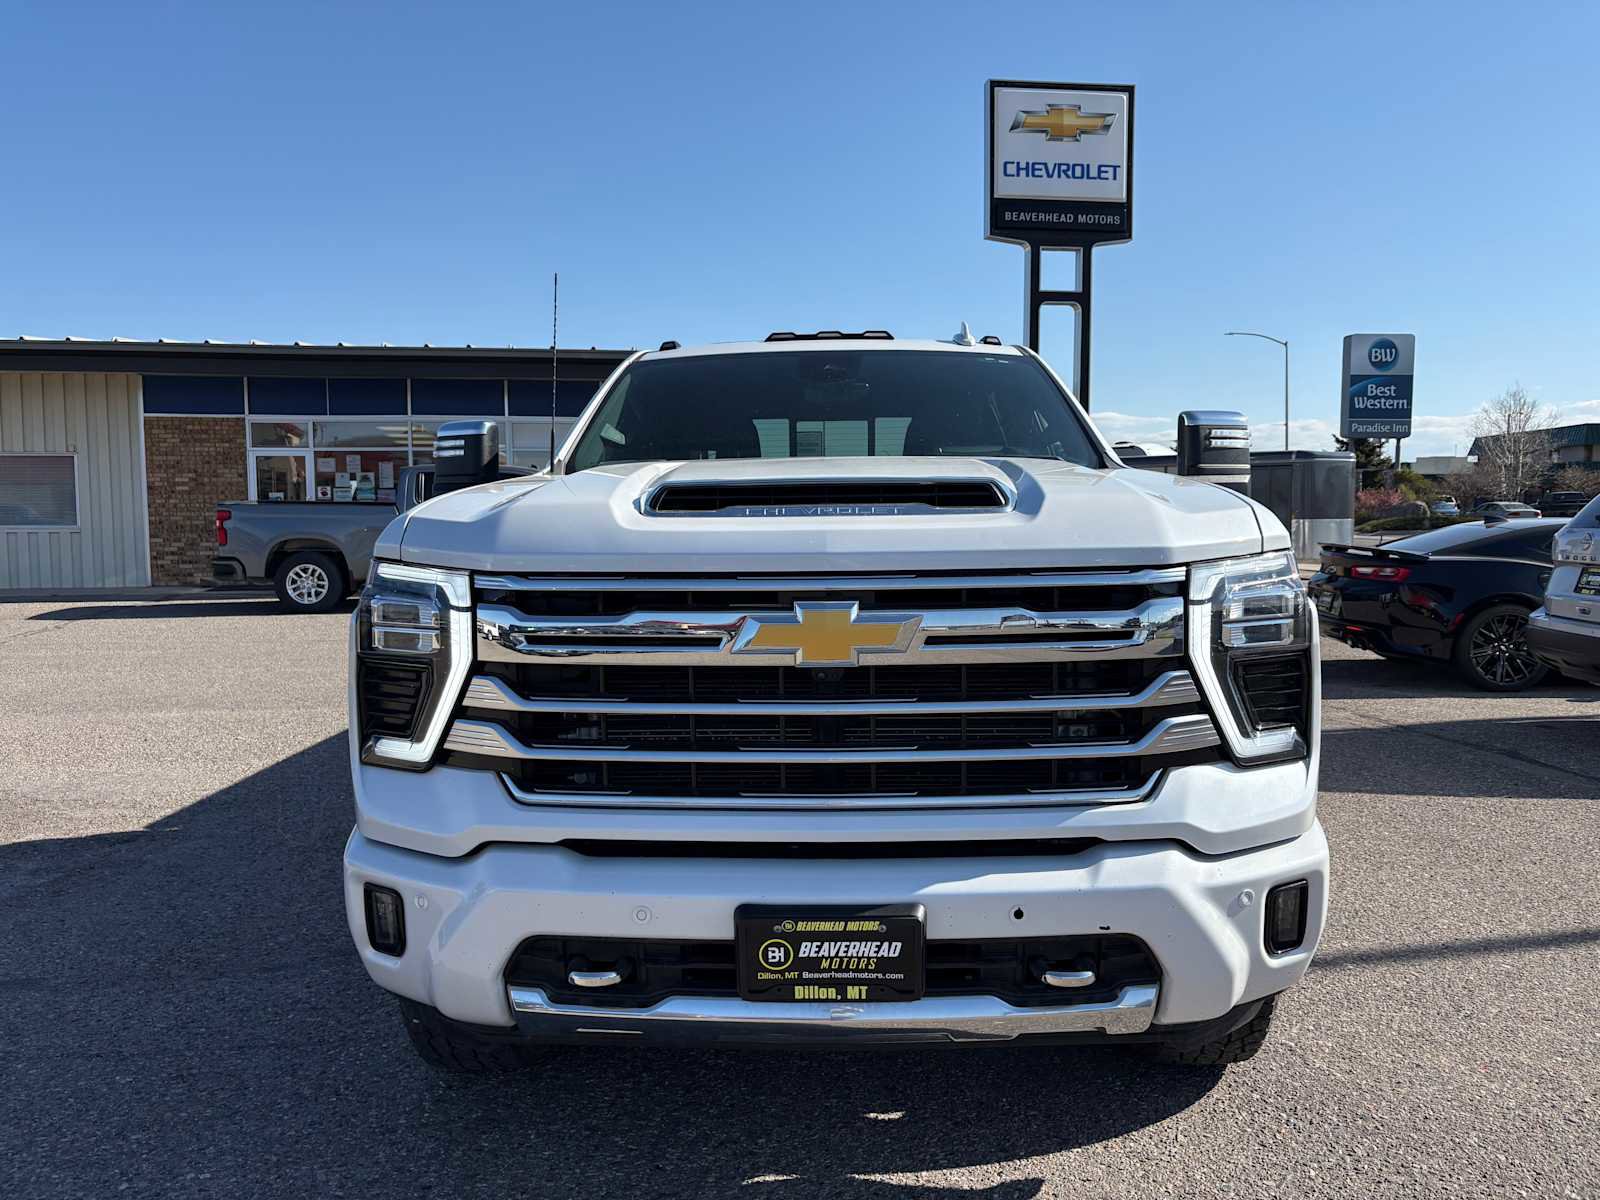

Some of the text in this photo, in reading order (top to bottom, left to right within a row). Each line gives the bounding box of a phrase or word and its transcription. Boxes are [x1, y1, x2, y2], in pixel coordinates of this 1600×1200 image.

[1003, 161, 1121, 181] CHEVROLET
[1004, 211, 1121, 225] BEAVERHEAD MOTORS
[1371, 348, 1396, 362] BW
[1367, 384, 1397, 396] Best
[1354, 397, 1408, 409] Western
[1351, 423, 1409, 433] Paradise Inn
[796, 921, 846, 931] BEAVERHEAD
[846, 921, 880, 931] MOTORS
[798, 941, 902, 958] BEAVERHEAD
[820, 958, 877, 970] MOTORS
[757, 971, 904, 980] Dillon, MT Beaverheadmotors.com
[794, 985, 868, 1000] Dillon, MT
